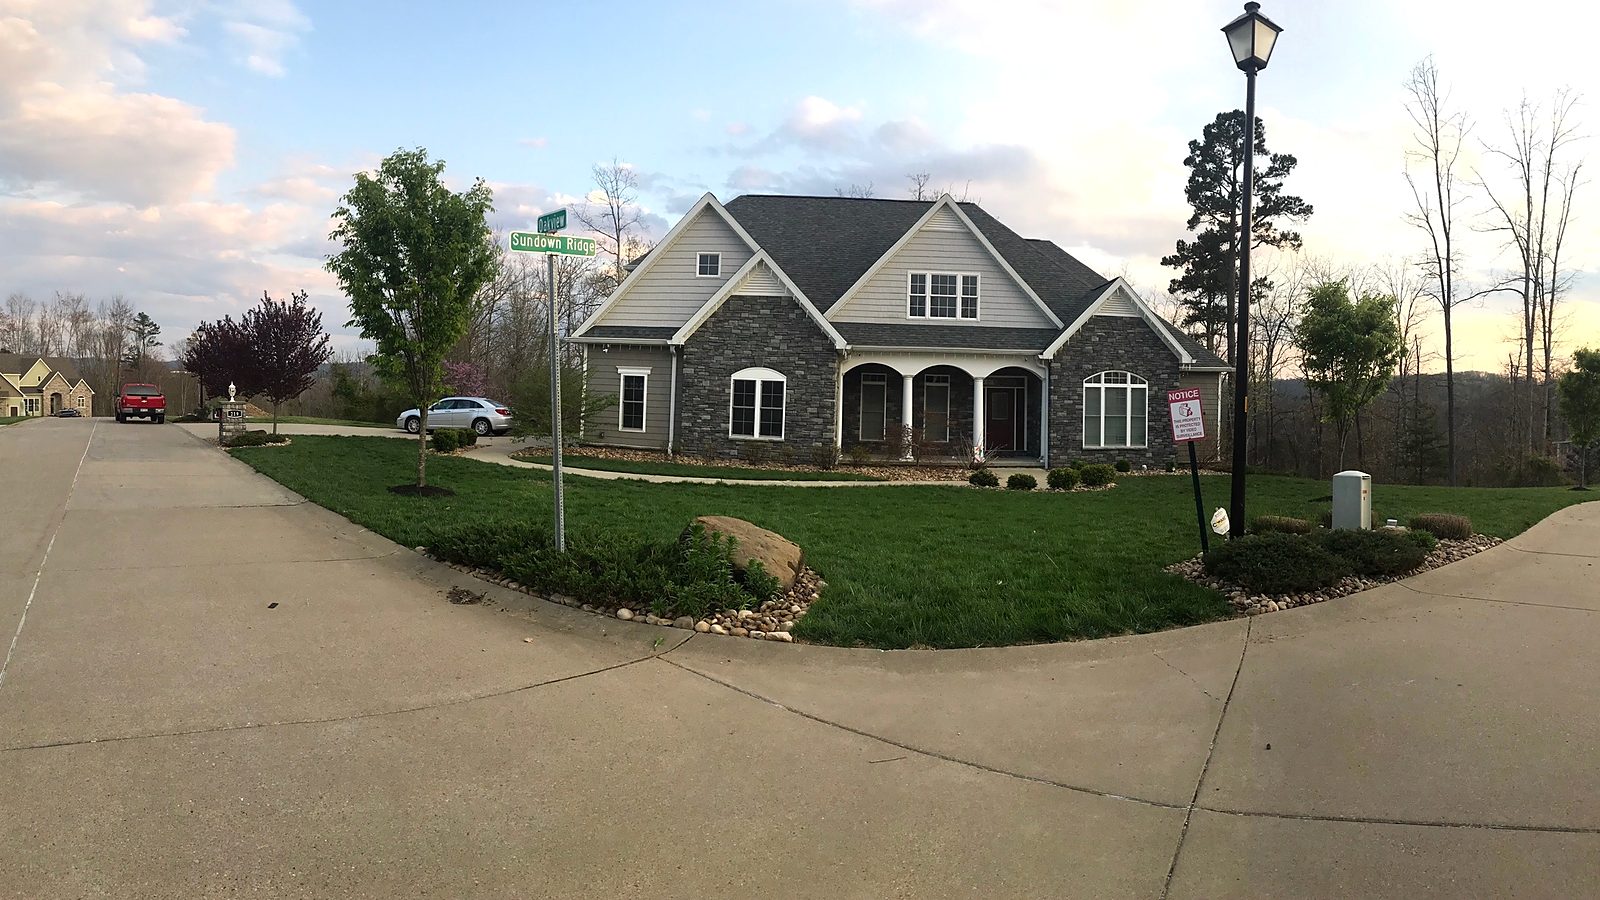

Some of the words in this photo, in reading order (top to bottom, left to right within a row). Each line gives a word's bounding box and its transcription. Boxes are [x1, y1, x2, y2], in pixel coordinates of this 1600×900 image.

[538, 214, 564, 232] Oakview
[512, 233, 562, 249] Sundown
[567, 238, 594, 255] Ridge
[1168, 390, 1199, 400] NOTICE
